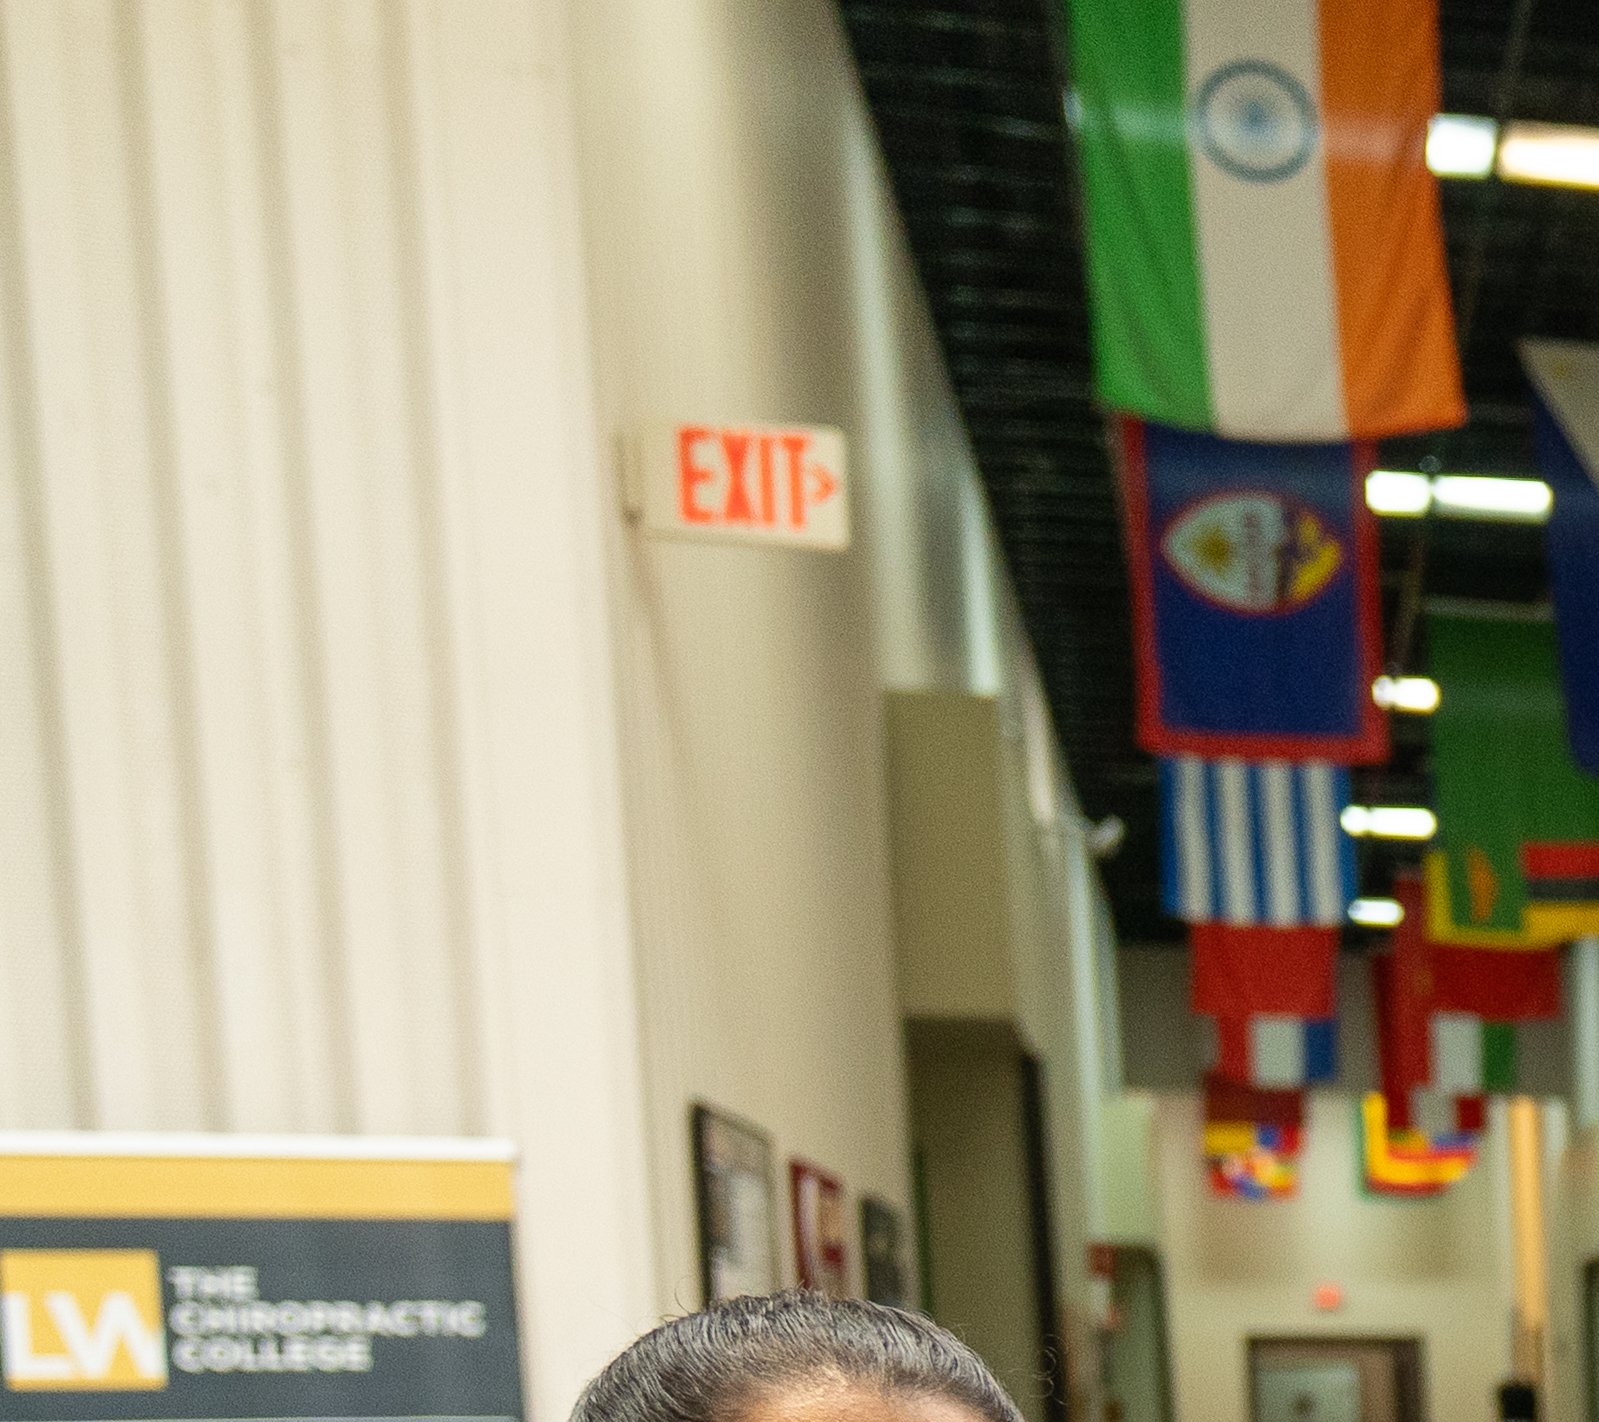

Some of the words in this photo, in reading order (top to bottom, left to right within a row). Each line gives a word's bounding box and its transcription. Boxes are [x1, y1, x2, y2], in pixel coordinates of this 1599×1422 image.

[677, 427, 810, 531] EXIT
[169, 1265, 259, 1300] THE
[169, 1300, 487, 1338] CHIROPRACTIC
[171, 1335, 374, 1372] COLLEGE
